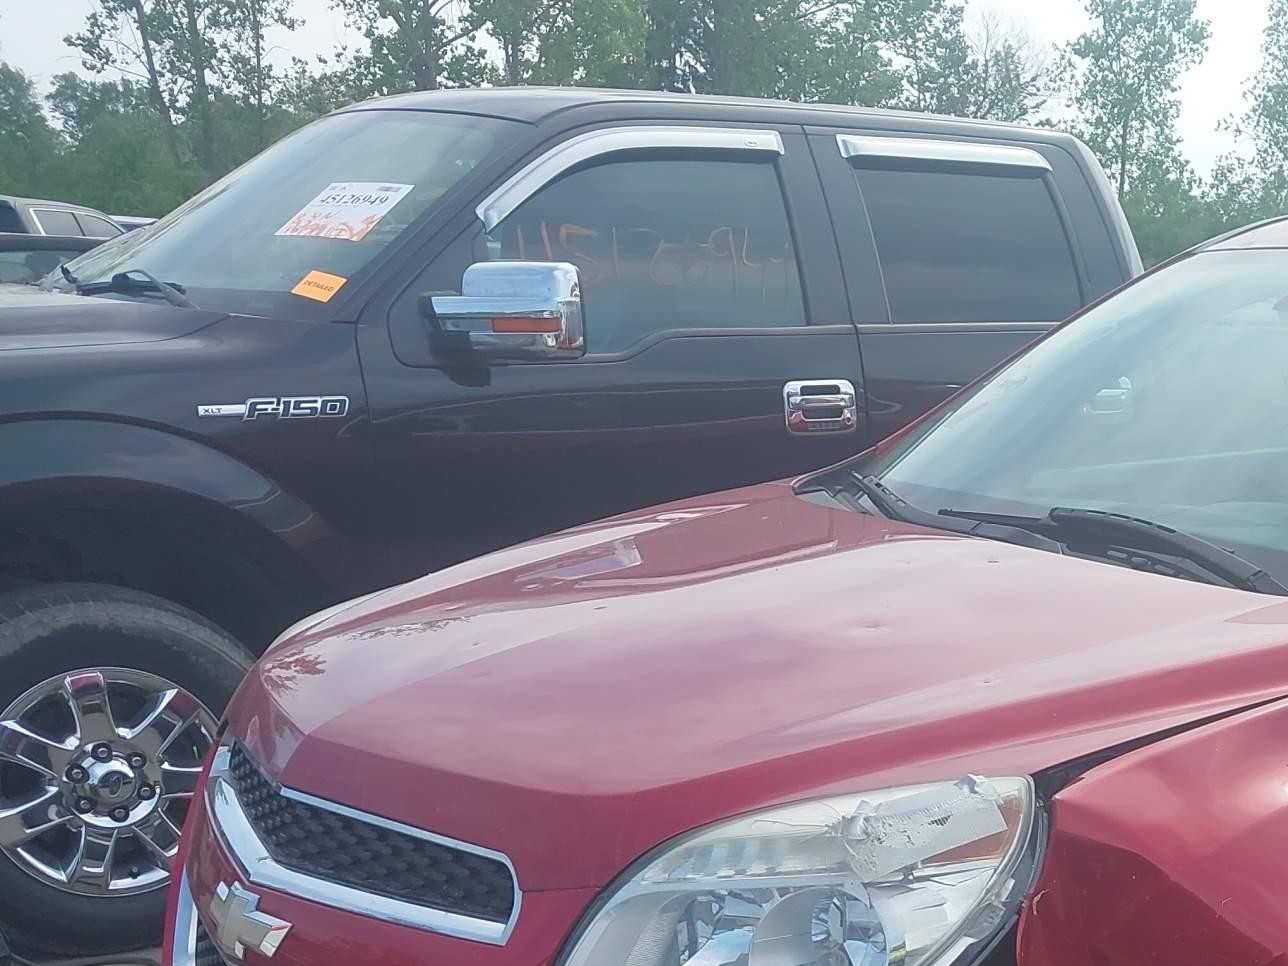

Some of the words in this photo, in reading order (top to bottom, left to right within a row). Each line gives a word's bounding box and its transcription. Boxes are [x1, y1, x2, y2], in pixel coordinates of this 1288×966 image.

[302, 279, 335, 293] DETAILED
[203, 407, 223, 415] XLT
[243, 395, 350, 420] F-150
